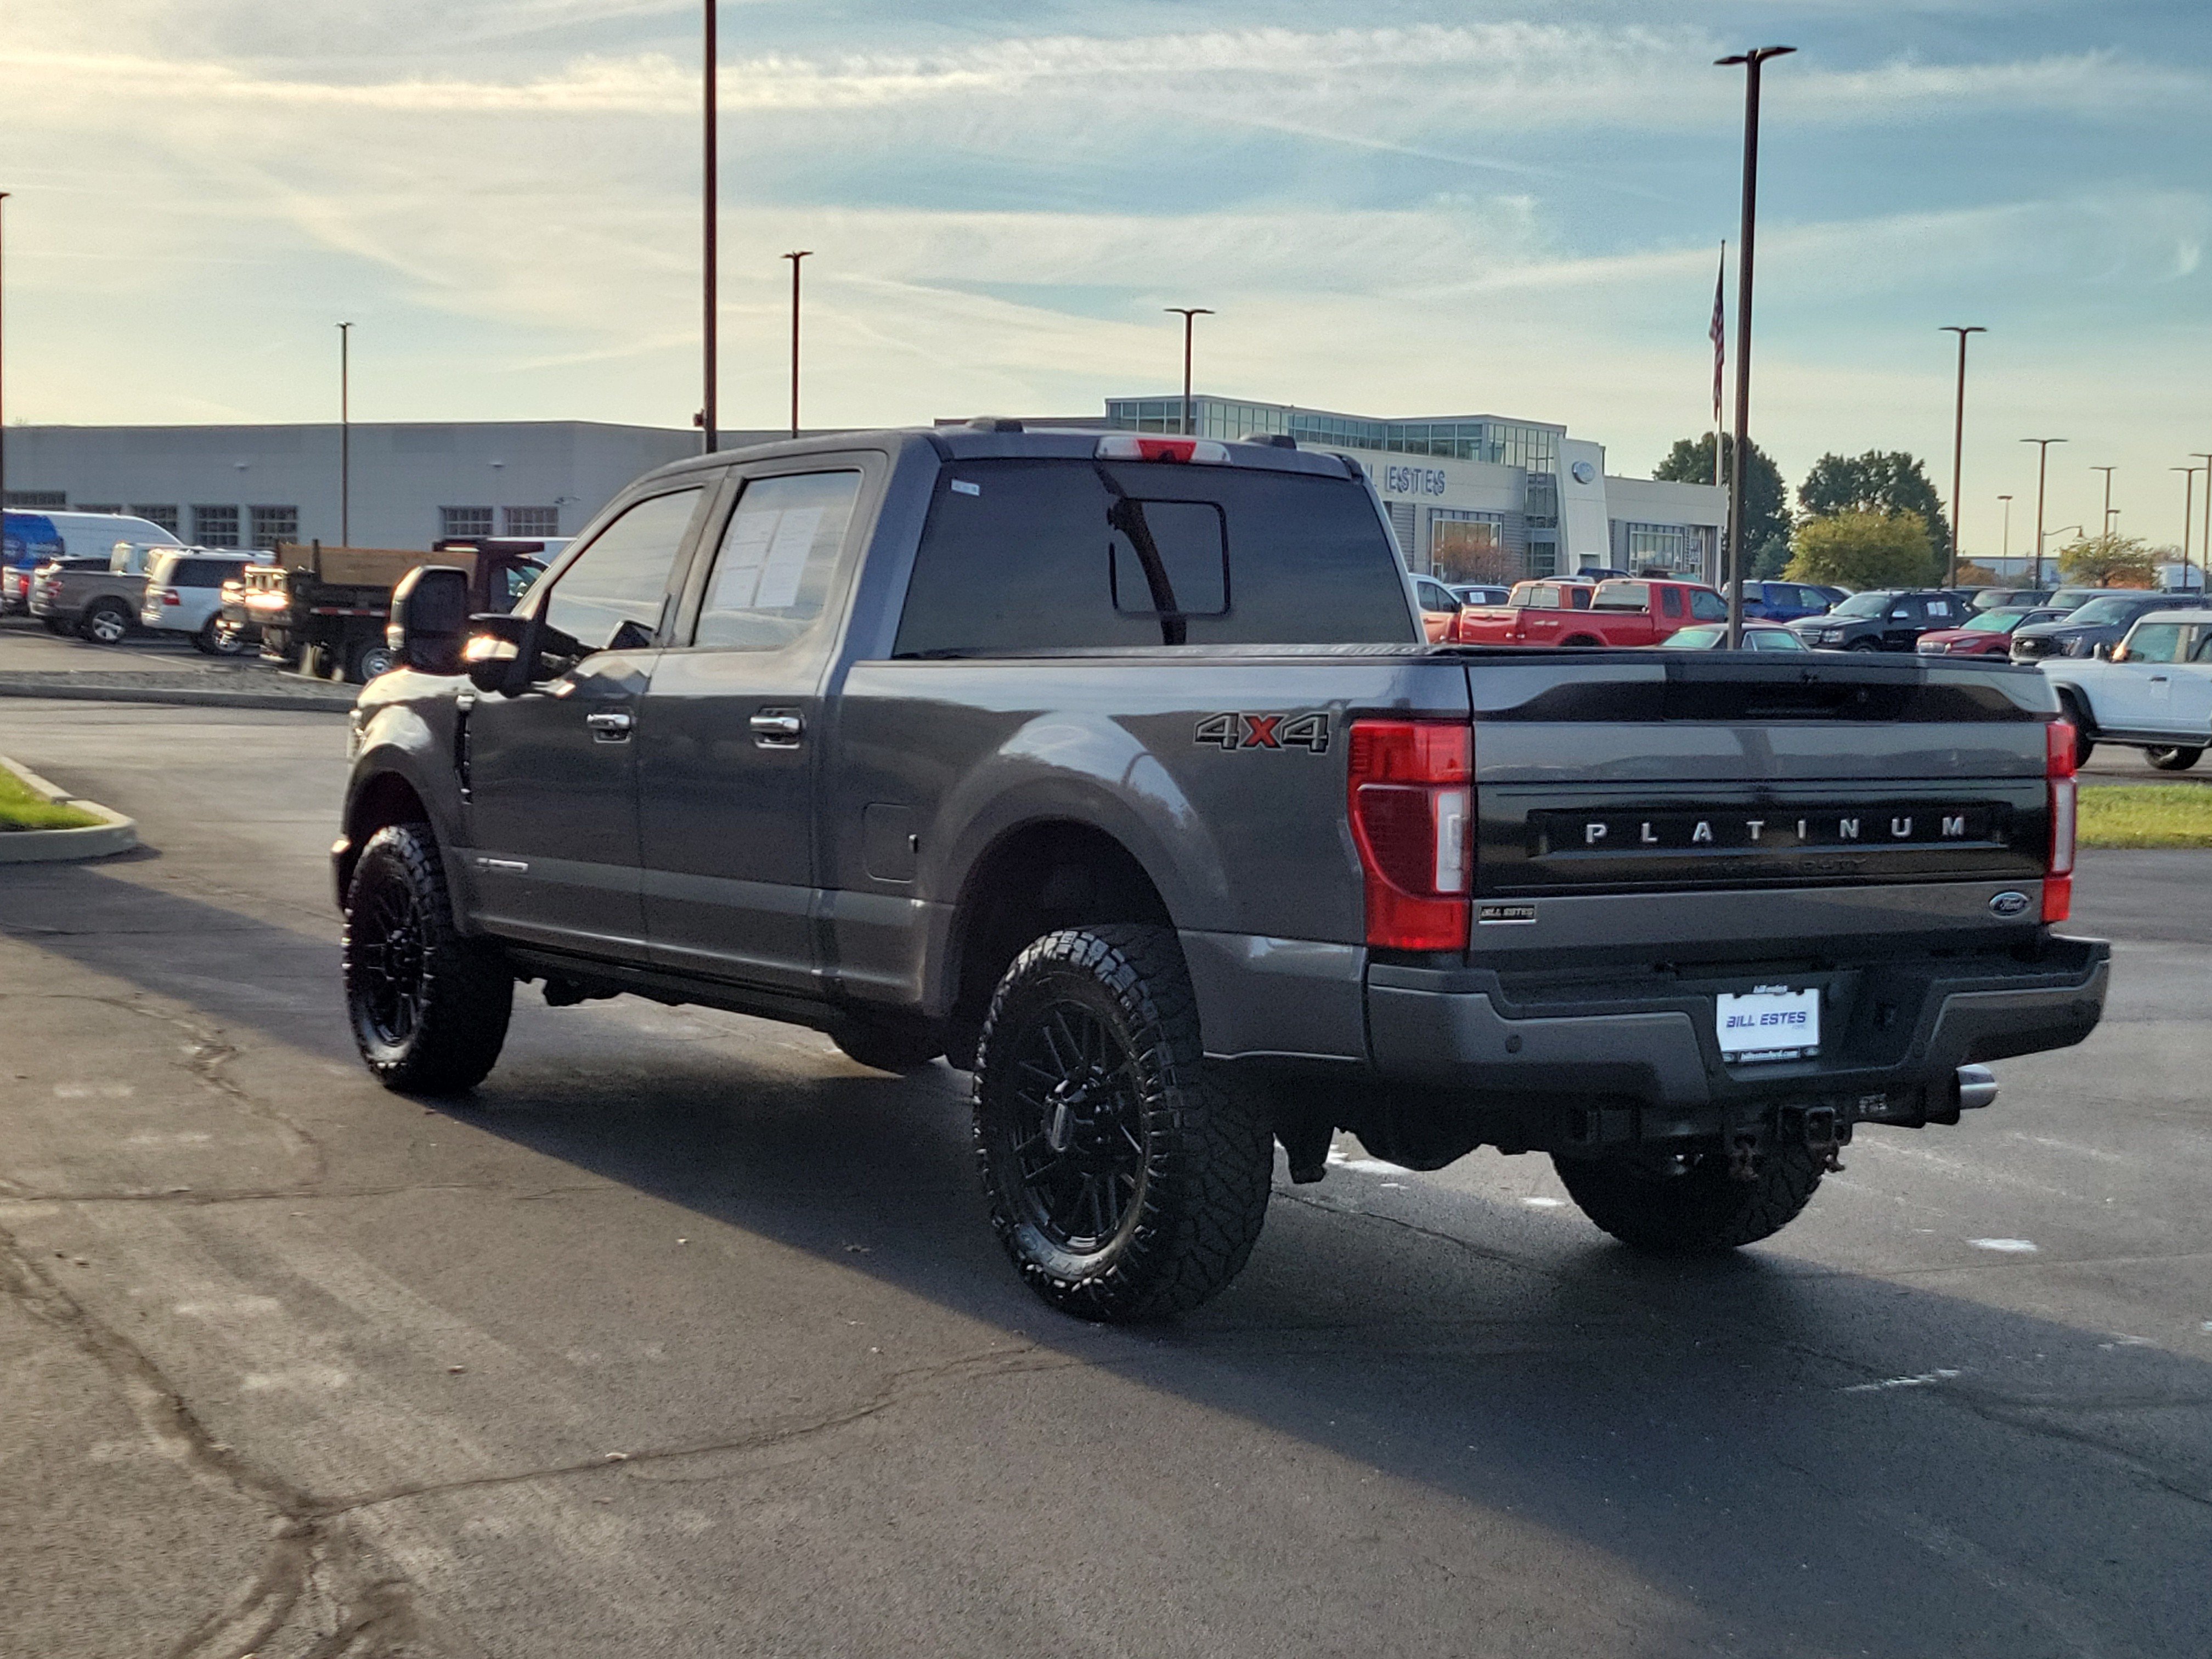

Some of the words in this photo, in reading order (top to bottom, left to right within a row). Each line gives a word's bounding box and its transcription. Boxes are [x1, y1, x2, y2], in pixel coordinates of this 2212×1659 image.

[1385, 465, 1446, 495] ESTES
[1585, 815, 1965, 843] PLATINUM
[1503, 907, 1534, 916] ESTES
[1726, 1015, 1755, 1028] BILL
[1760, 1011, 1806, 1025] ESTES
